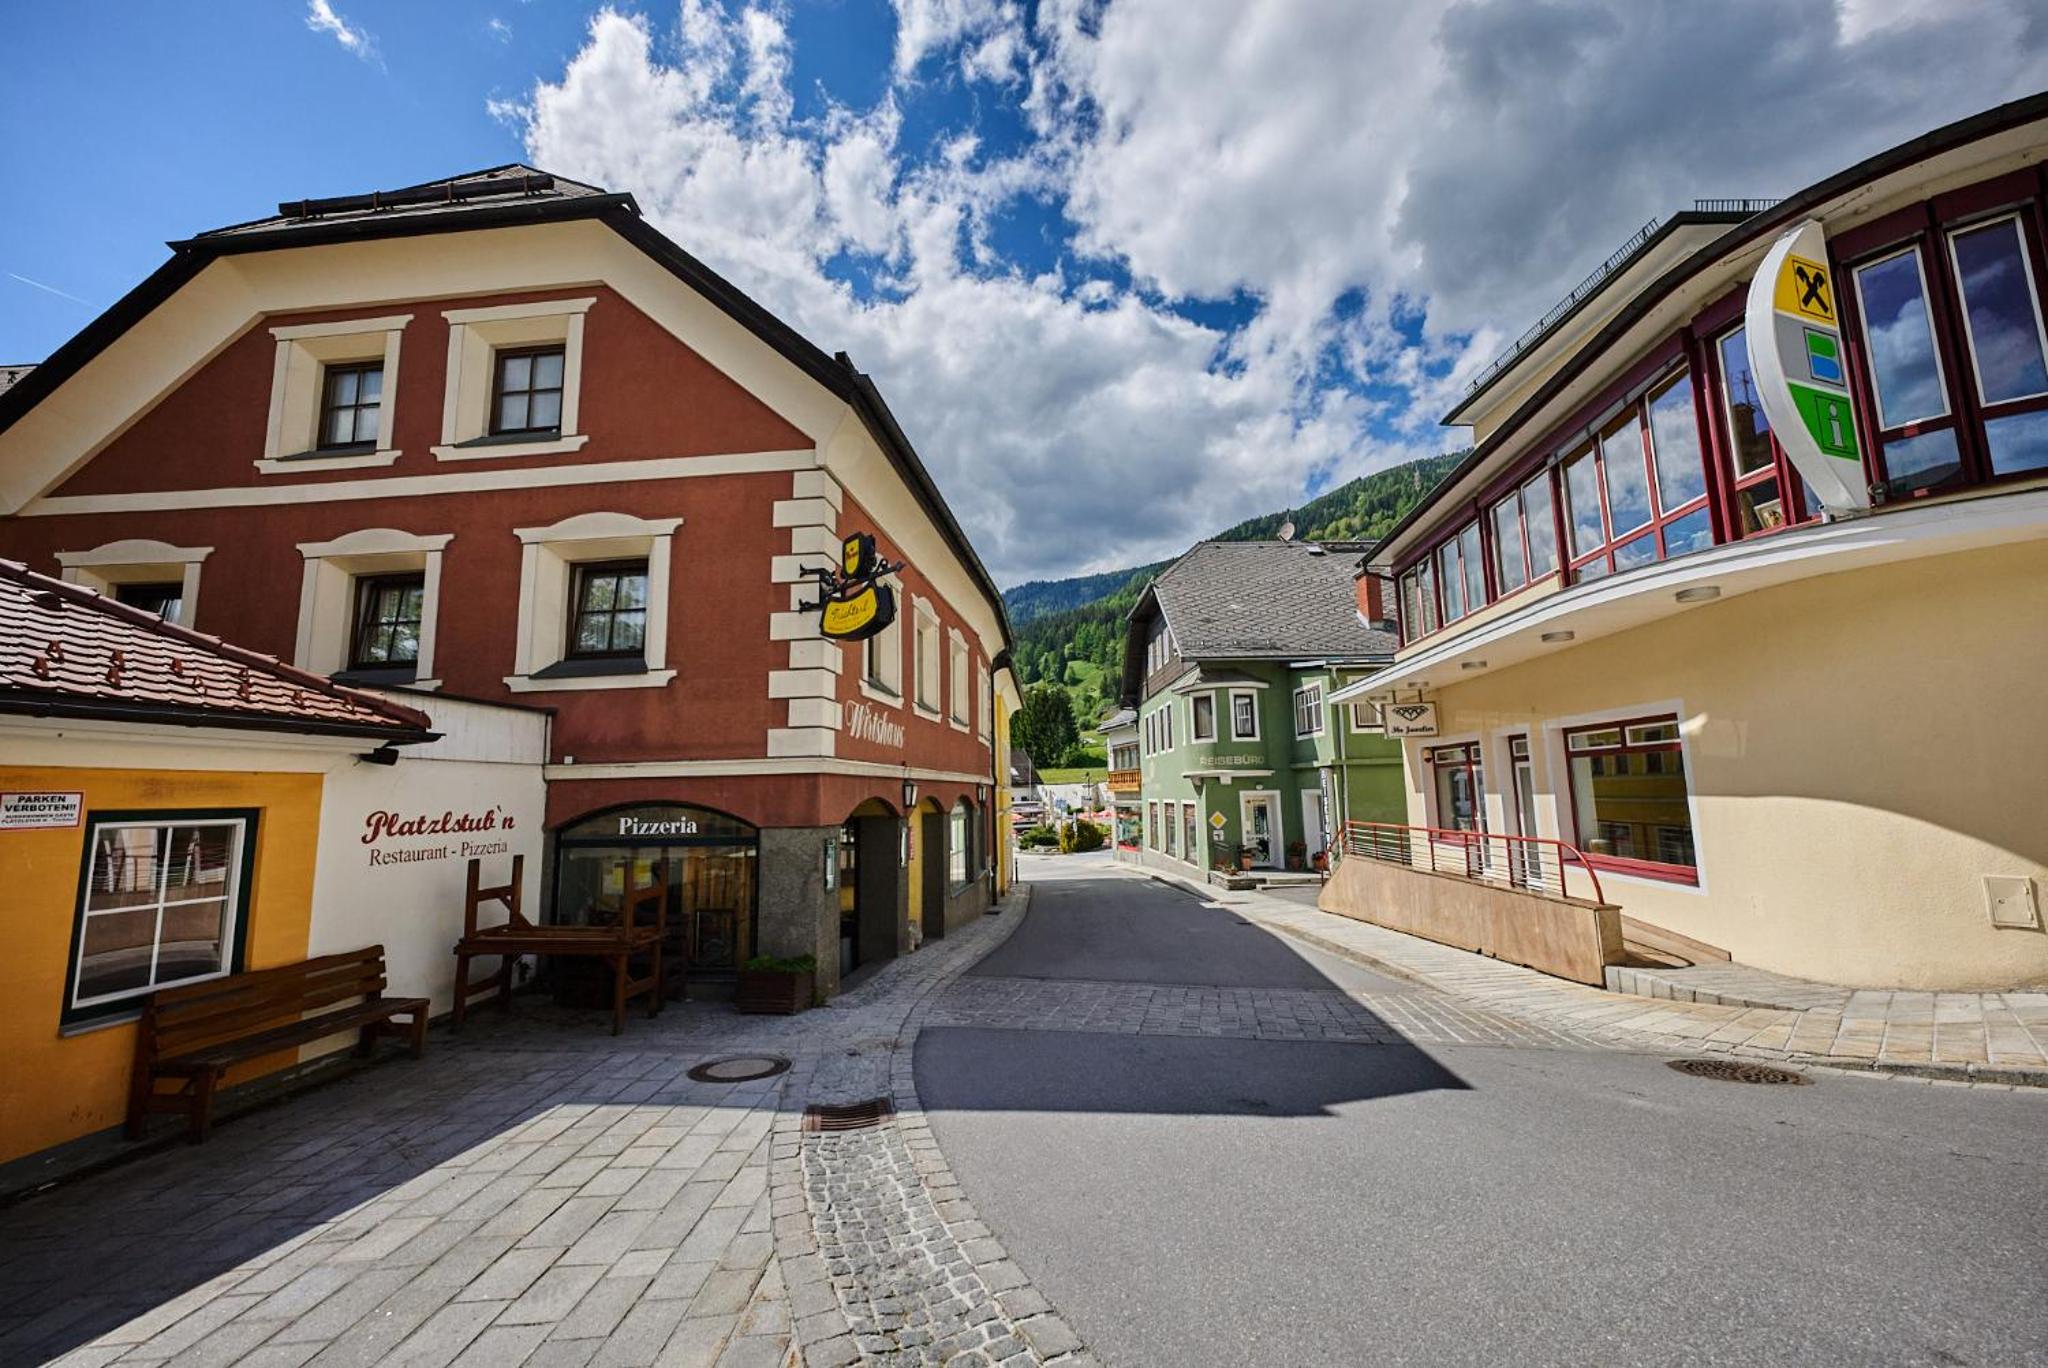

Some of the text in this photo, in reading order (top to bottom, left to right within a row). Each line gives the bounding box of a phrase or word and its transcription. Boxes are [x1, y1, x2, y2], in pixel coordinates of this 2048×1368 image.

[845, 700, 904, 749] Wirtshaus
[1200, 753, 1265, 767] REISEBÜRO
[18, 796, 66, 804] PARKEN
[619, 816, 698, 835] Pizzeria
[369, 846, 449, 866] Restaurant
[461, 840, 508, 857] Pizzeria
